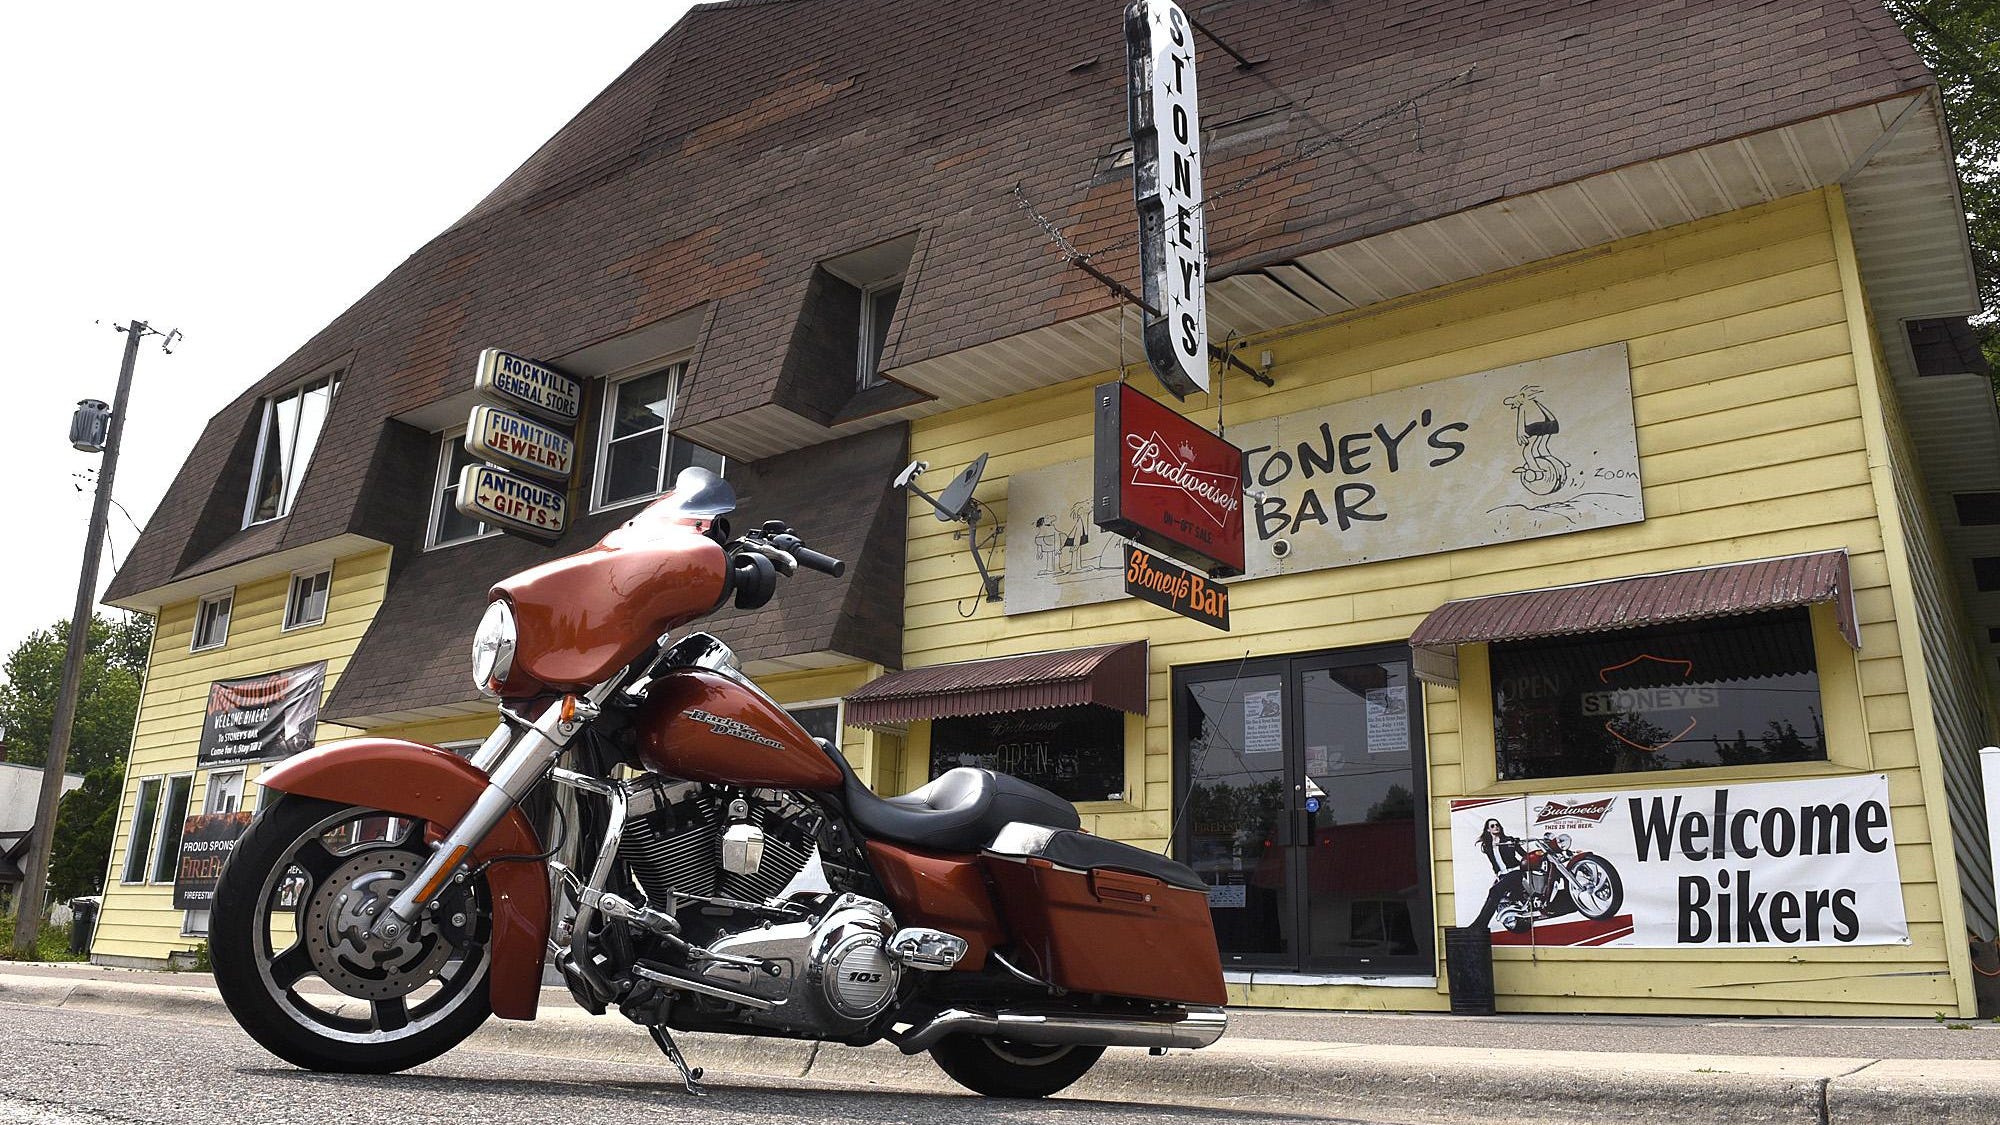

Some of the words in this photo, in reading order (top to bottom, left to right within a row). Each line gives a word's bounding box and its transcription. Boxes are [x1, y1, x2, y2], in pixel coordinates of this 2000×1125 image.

[1169, 7, 1200, 357] STONEY'S
[497, 373, 542, 403] GENERAL
[546, 393, 575, 416] STORE
[503, 357, 574, 397] ROCKVILLE
[488, 432, 567, 471] JEWELRY
[492, 414, 569, 455] FURNITURE
[1241, 409, 1469, 489] TONEY'S
[482, 472, 561, 511] ANTIQUES
[1126, 434, 1238, 511] Budweiser
[494, 495, 547, 524] GIFTS
[1255, 483, 1388, 541] BAR
[1128, 550, 1189, 609] Stoney's
[1190, 574, 1228, 619] Bar
[214, 710, 243, 729] WELCOME
[243, 708, 270, 725] BIKERS
[1584, 688, 1715, 713] STONEY'S
[210, 747, 224, 755] Come
[225, 745, 233, 754] for
[238, 744, 250, 754] Stay
[224, 730, 247, 742] STONEY'S
[997, 742, 1049, 776] OPEN
[1534, 803, 1613, 817] Budweiser
[1628, 789, 1888, 863] Welcome
[183, 841, 208, 851] PROUD
[209, 840, 237, 851] SPONS
[1677, 868, 1859, 944] Bikers
[849, 972, 882, 982] 103
